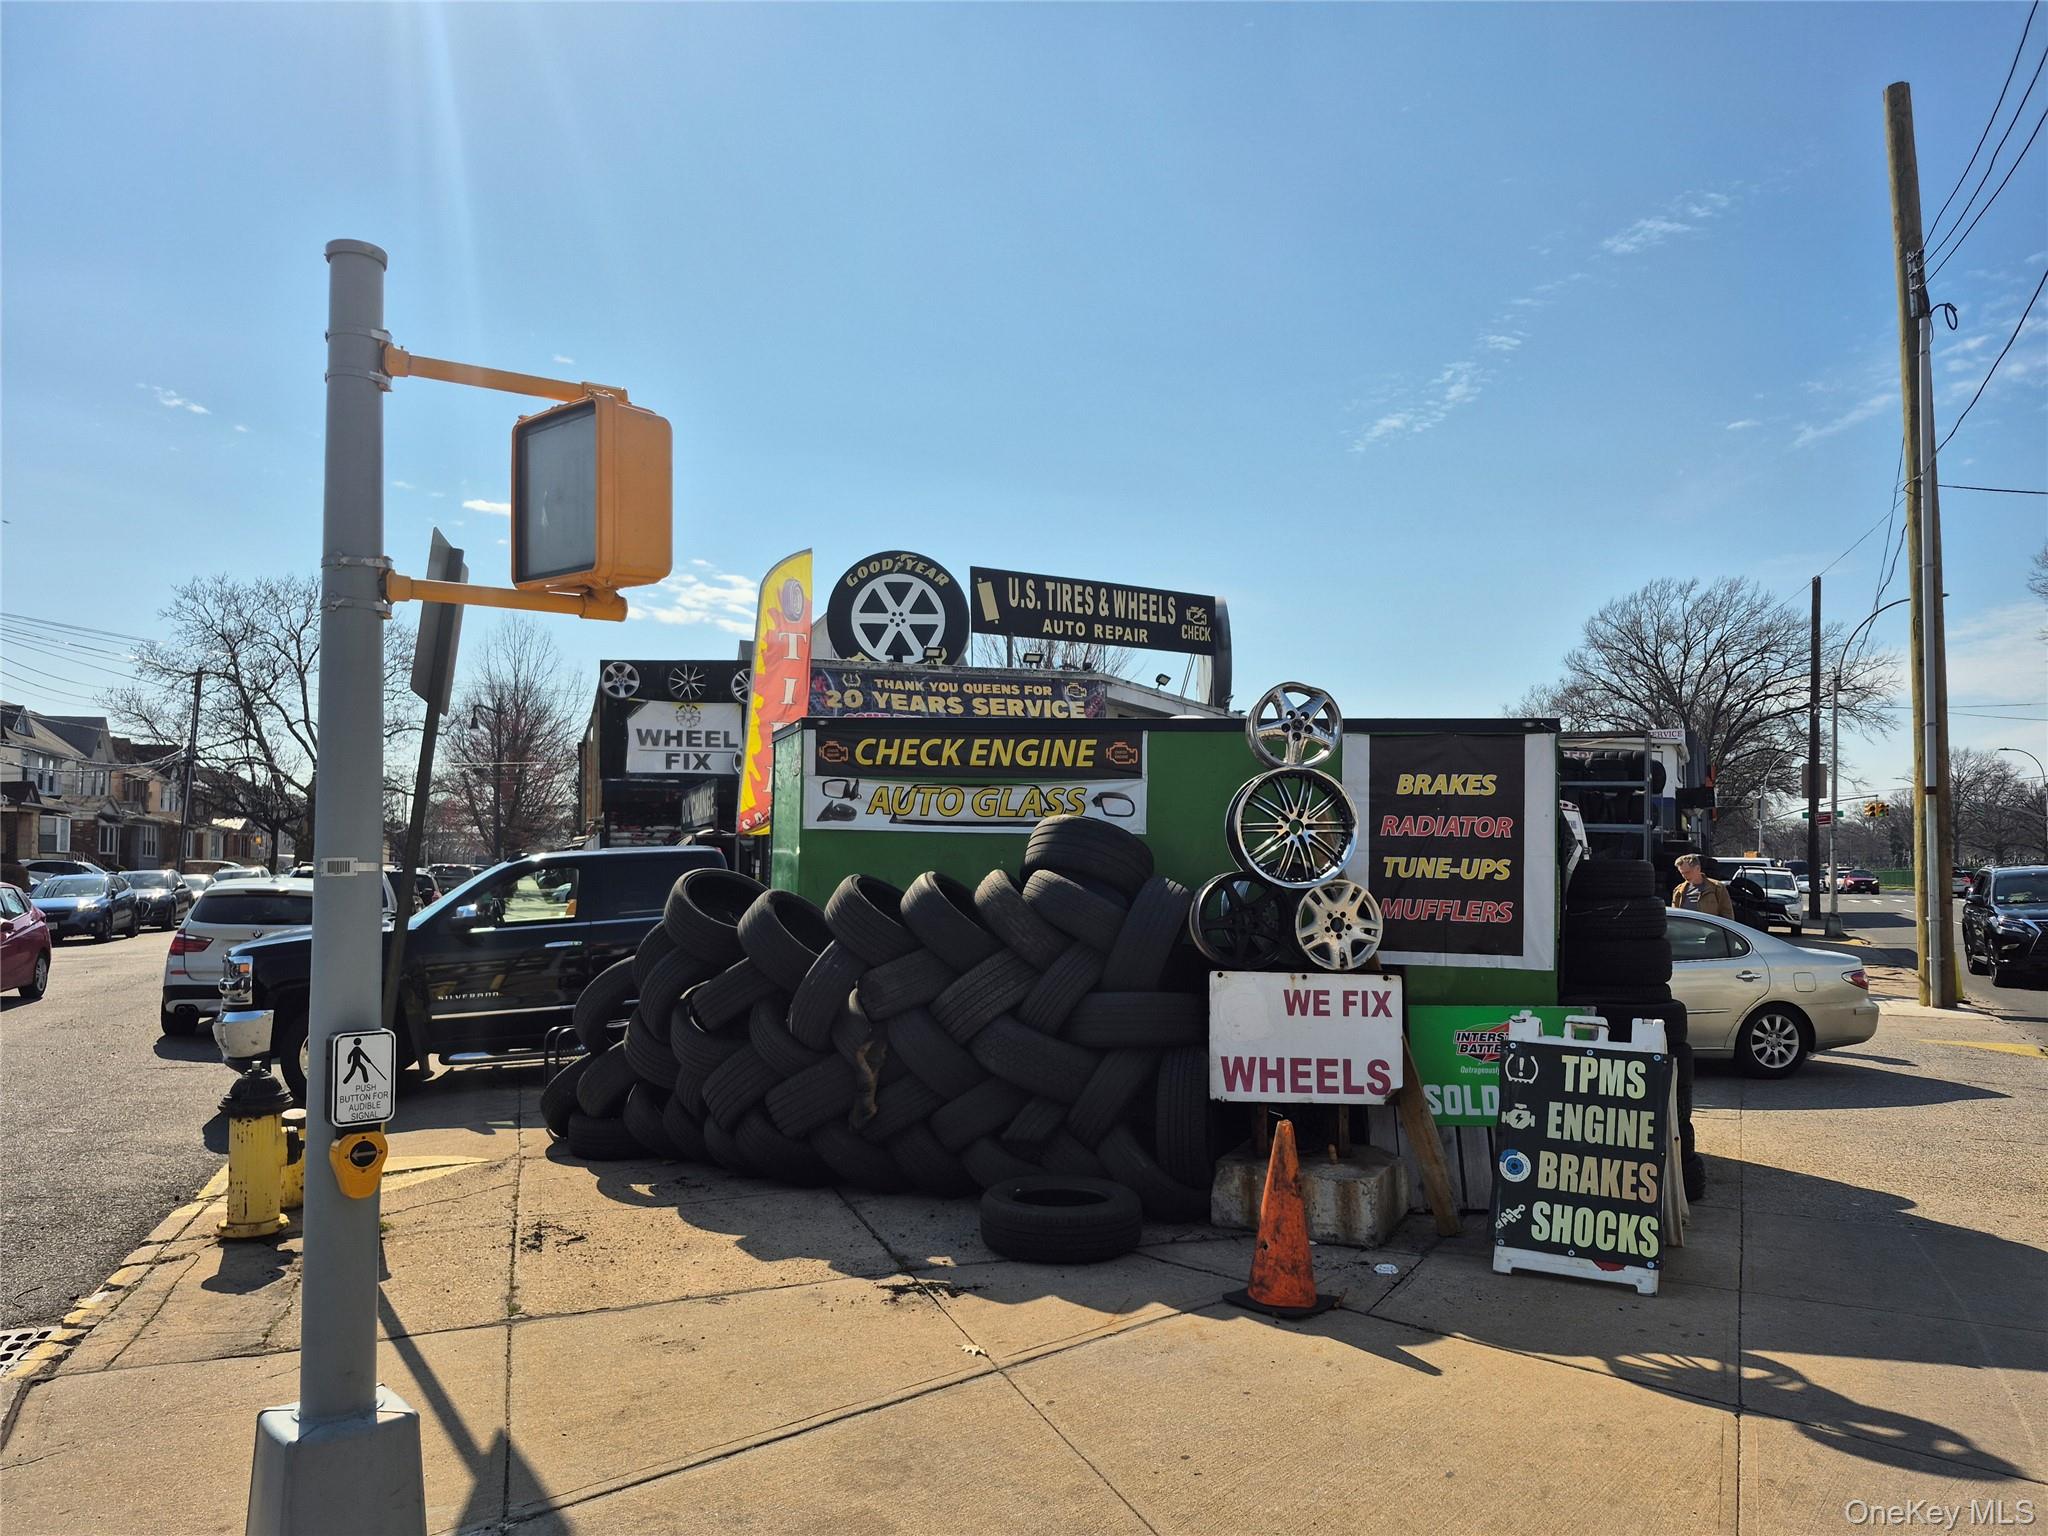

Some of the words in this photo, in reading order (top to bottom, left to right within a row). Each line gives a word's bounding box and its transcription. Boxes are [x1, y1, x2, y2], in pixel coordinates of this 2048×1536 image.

[846, 557, 950, 587] GOODYEAR
[1008, 577, 1041, 610] U.S.
[1045, 582, 1093, 616] TIRES
[1099, 588, 1110, 617] &
[1113, 590, 1176, 625] WHEELS
[1042, 619, 1086, 637] AUTO
[1094, 623, 1148, 643] REPAIR
[1182, 625, 1211, 642] CHECK
[874, 679, 924, 692] THANK
[929, 682, 959, 694] YOU
[963, 682, 1020, 696] QUEENS
[1024, 685, 1053, 696] FOR
[825, 689, 864, 709] 20
[871, 691, 965, 715] YEARS
[972, 698, 1087, 718] SERVICE
[636, 728, 739, 749] WHEEL
[1651, 730, 1683, 738] ERVICE
[665, 752, 713, 771] FIX
[855, 738, 965, 767] CHECK
[969, 738, 1098, 768] ENGINE
[1396, 773, 1498, 796] BRAKES
[865, 786, 966, 817] AUTO
[970, 786, 1088, 818] GLASS
[1380, 815, 1514, 839] RADIATOR
[1383, 856, 1512, 881] TUNE-UPS
[1380, 897, 1514, 924] MUFFLERS
[1283, 989, 1331, 1017] WE
[1342, 990, 1393, 1018] FIX
[1460, 1044, 1501, 1053] BATTE
[355, 1084, 377, 1092] PUSH
[1220, 1055, 1393, 1096] WHEELS
[1561, 1054, 1647, 1100] TPMS
[339, 1093, 371, 1104] BUTTON
[372, 1091, 389, 1101] FOR
[348, 1101, 381, 1112] AUDIBLE
[1423, 1084, 1500, 1117] SOLD
[351, 1112, 379, 1121] SIGNAL
[1546, 1101, 1655, 1150] ENGINE
[1537, 1150, 1658, 1204] BRAKES
[1531, 1200, 1660, 1258] SHOCKS
